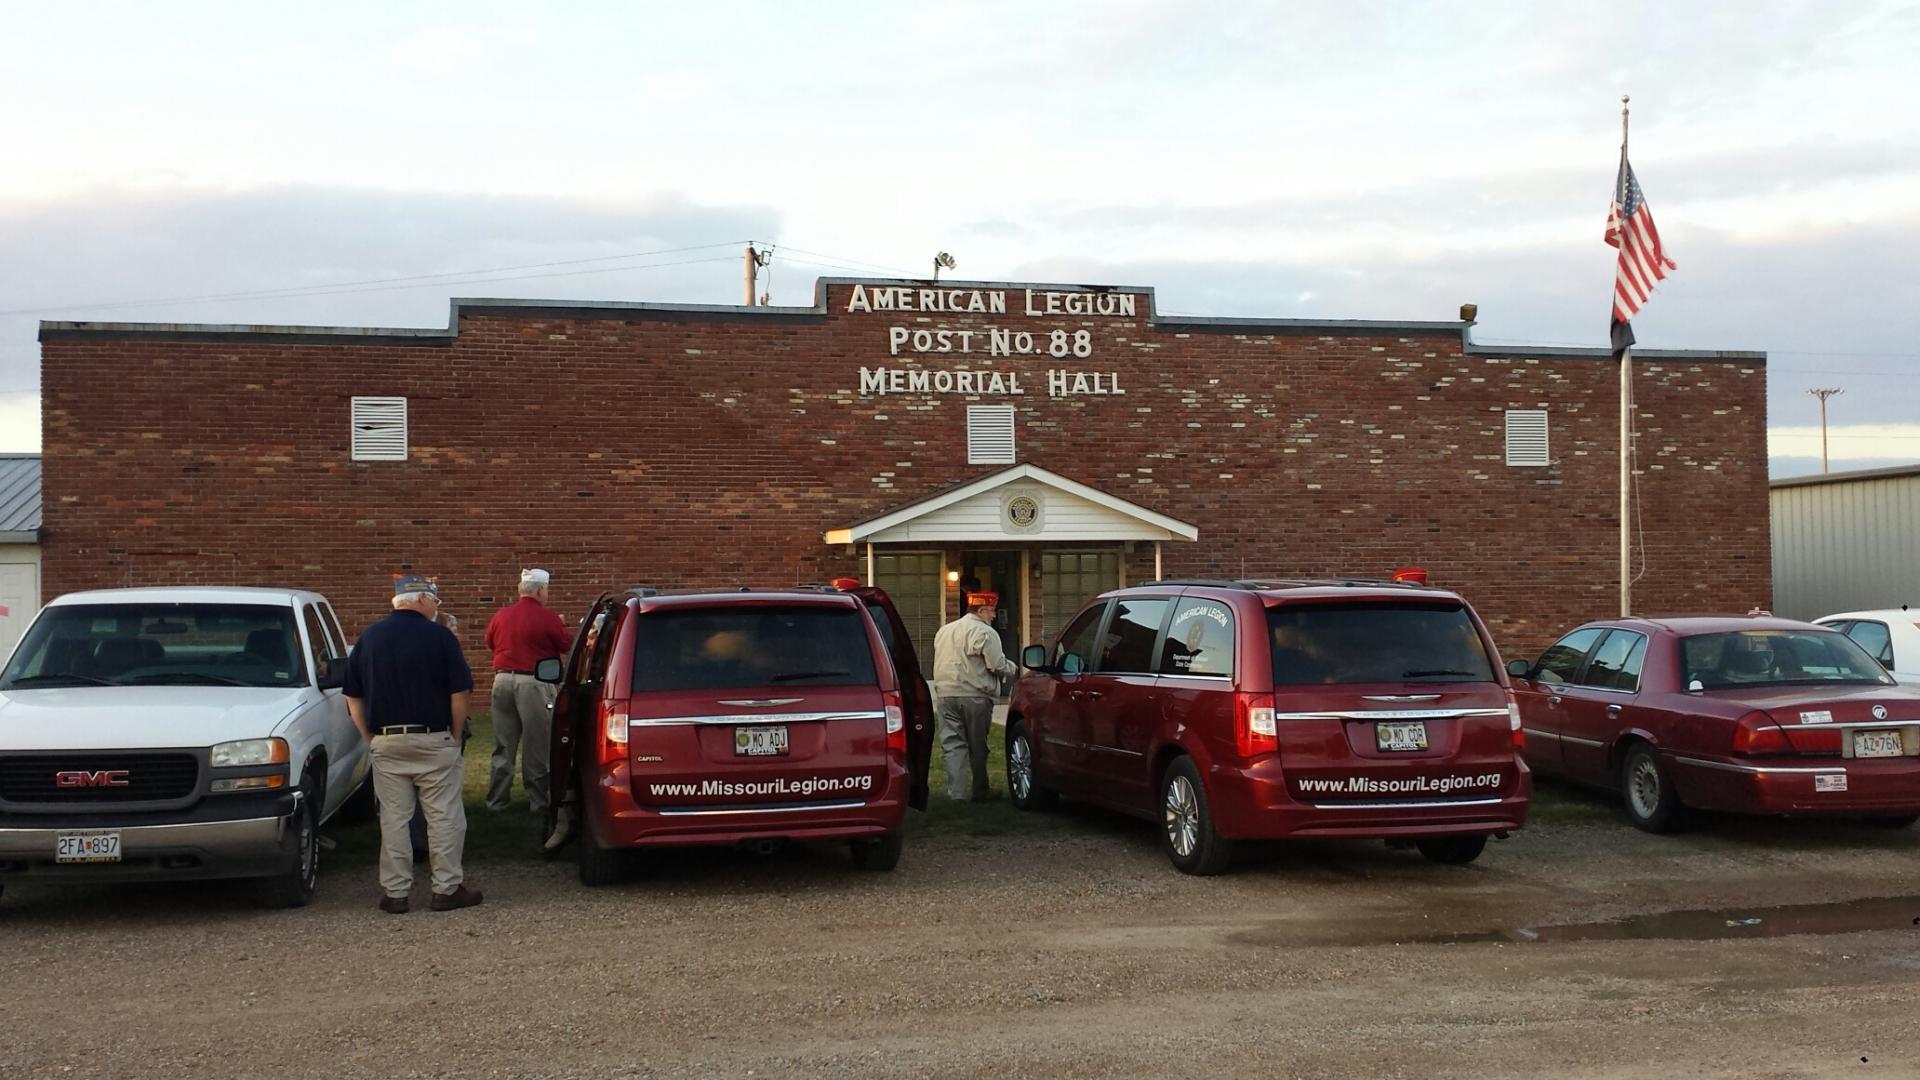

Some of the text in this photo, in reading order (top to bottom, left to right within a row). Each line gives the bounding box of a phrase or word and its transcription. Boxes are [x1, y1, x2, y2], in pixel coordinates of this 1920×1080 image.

[848, 284, 1136, 316] AMERICAN LEGION
[889, 327, 974, 355] POST
[860, 366, 1126, 397] MEMORIAL HALL
[1175, 606, 1208, 626] AMERICAN
[753, 732, 786, 748] MO ADJ
[1393, 728, 1404, 742] MO
[56, 770, 130, 788] GMC
[650, 774, 873, 797] www.MissouriLegion.org
[1298, 772, 1502, 794] www.MissouriLegion.org
[59, 837, 118, 855] 2FA 897
